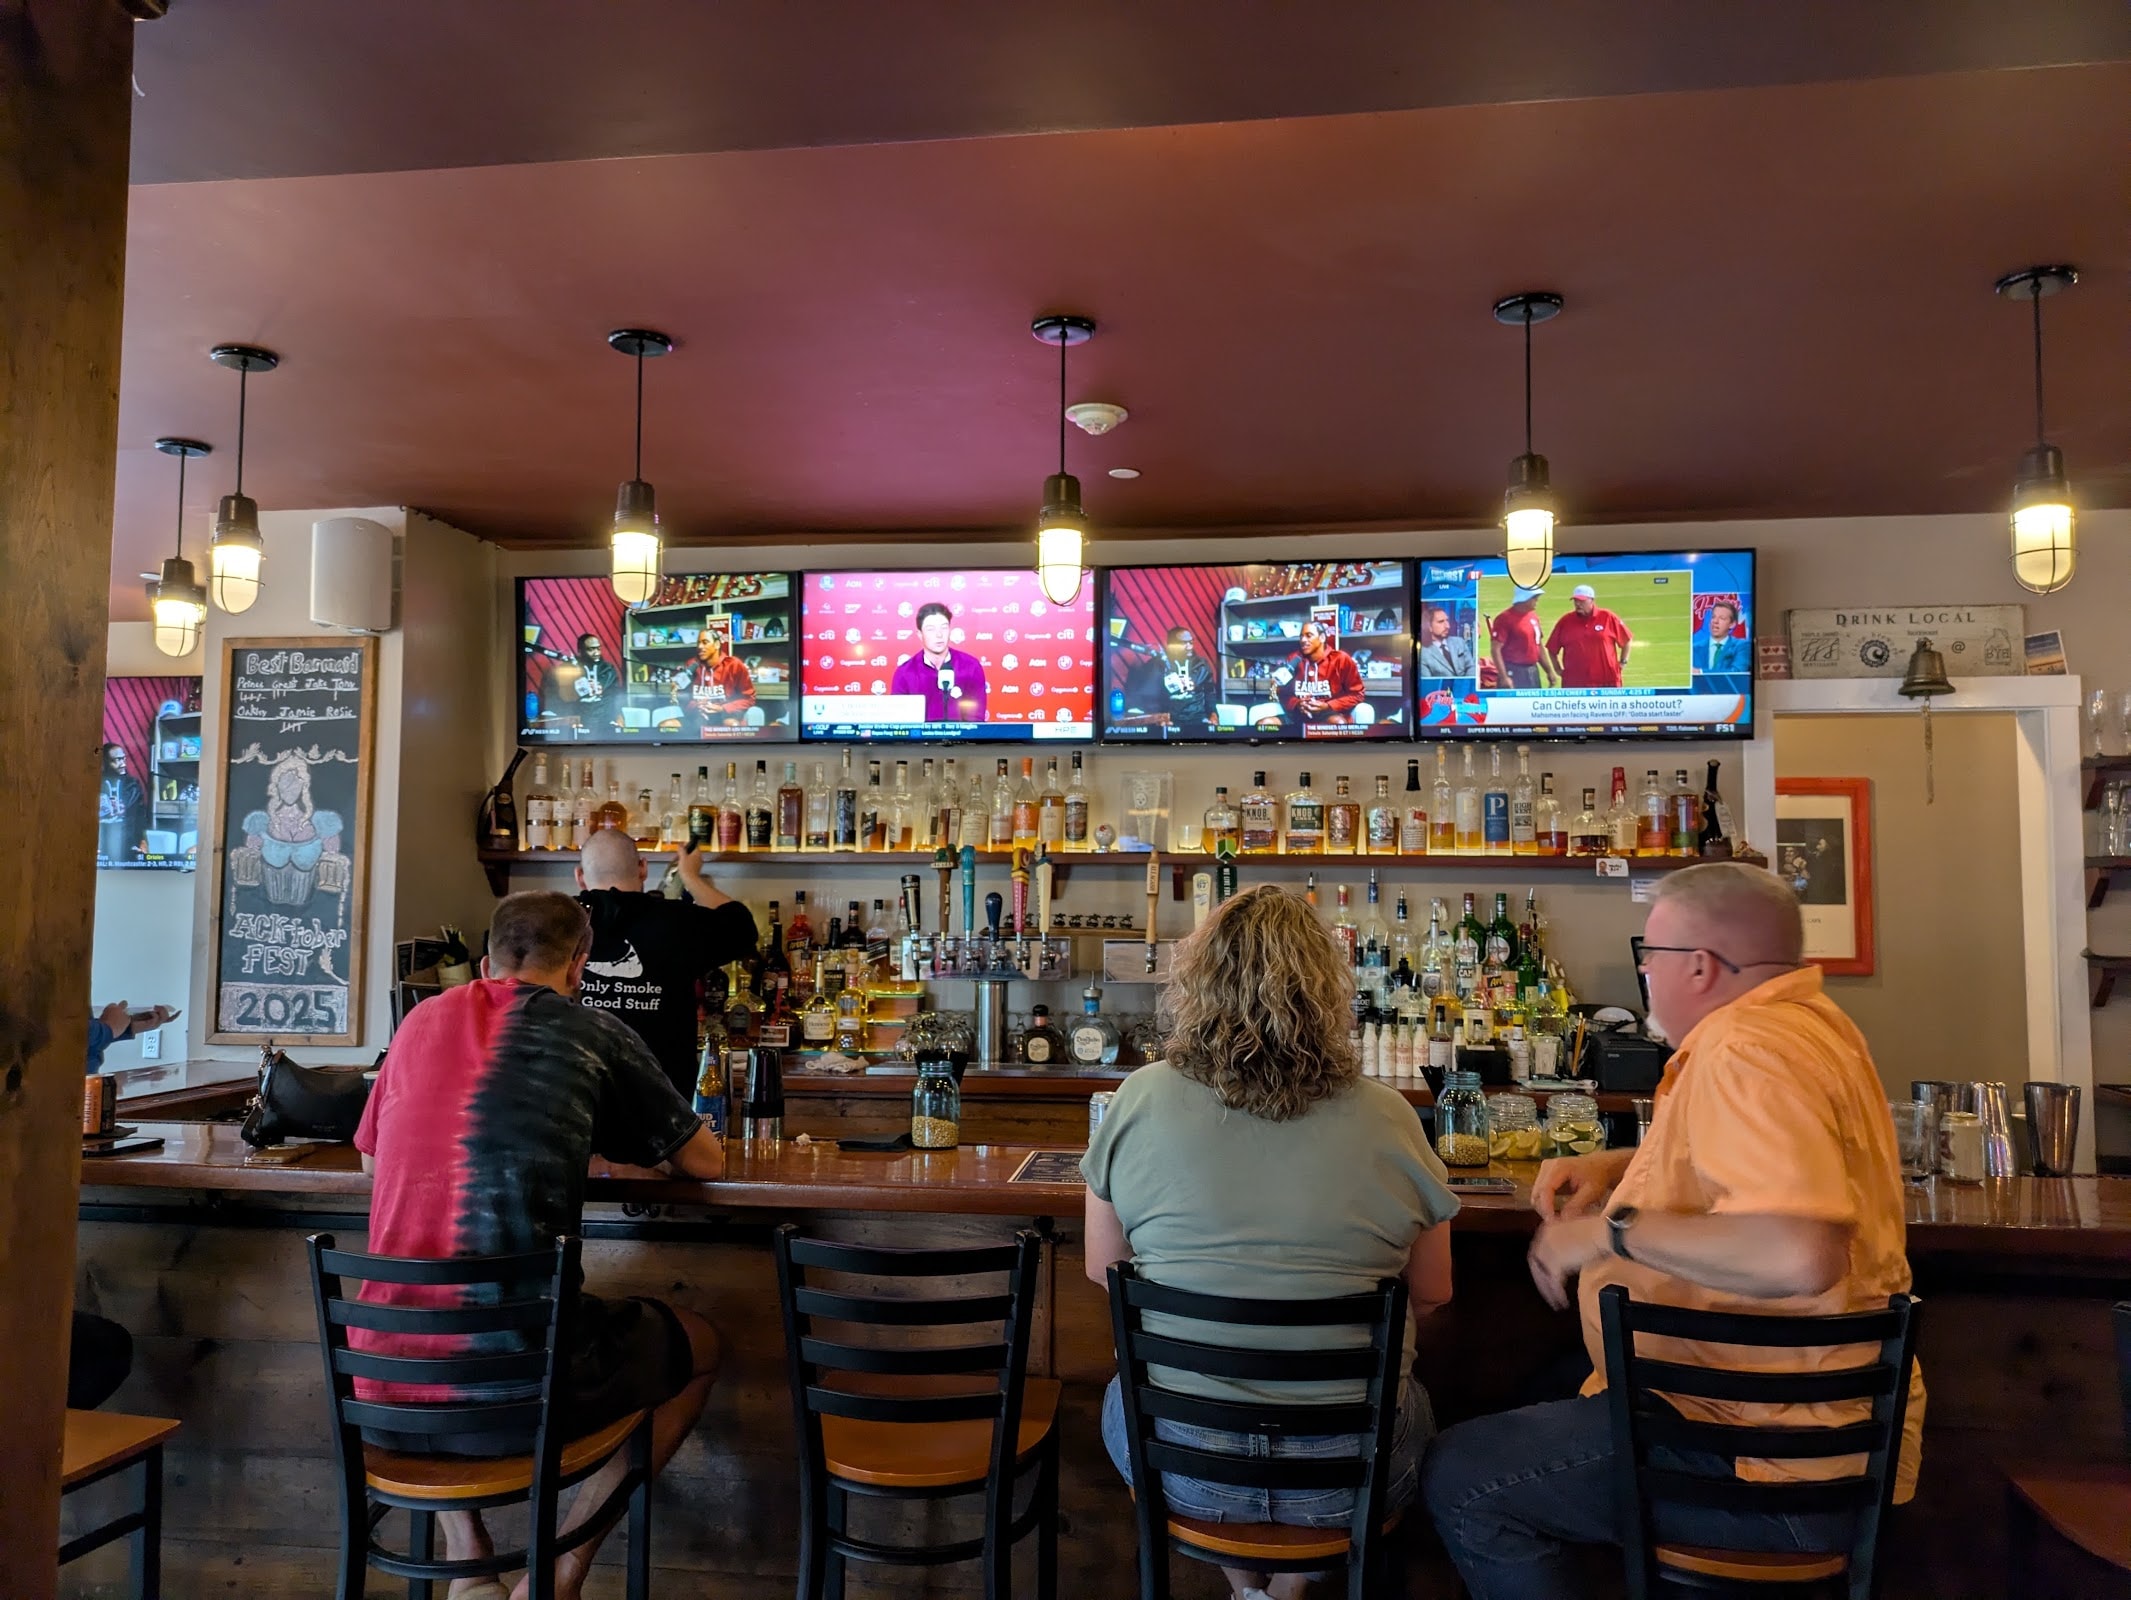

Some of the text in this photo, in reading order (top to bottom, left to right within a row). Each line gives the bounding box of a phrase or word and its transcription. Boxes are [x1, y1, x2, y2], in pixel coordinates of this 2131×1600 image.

[1836, 612, 1977, 627] DRINK LOCAL
[246, 651, 359, 675] Best Barmaid
[1294, 679, 1331, 692] EAGLES
[279, 706, 316, 717] Jamie
[1532, 701, 1552, 711] Can
[1554, 699, 1587, 710] Chiefs
[1588, 699, 1607, 710] win
[1609, 699, 1619, 709] in
[1629, 699, 1682, 709] shootout?
[1570, 712, 1589, 720] facing
[1716, 724, 1735, 733] FS1
[1246, 808, 1267, 817] KNOB
[1291, 807, 1313, 817] KNOB
[1489, 797, 1505, 816] P
[242, 944, 313, 976] FEST
[614, 981, 662, 994] Smoke
[236, 990, 337, 1028] 2025
[581, 996, 661, 1010] Good Stuff
